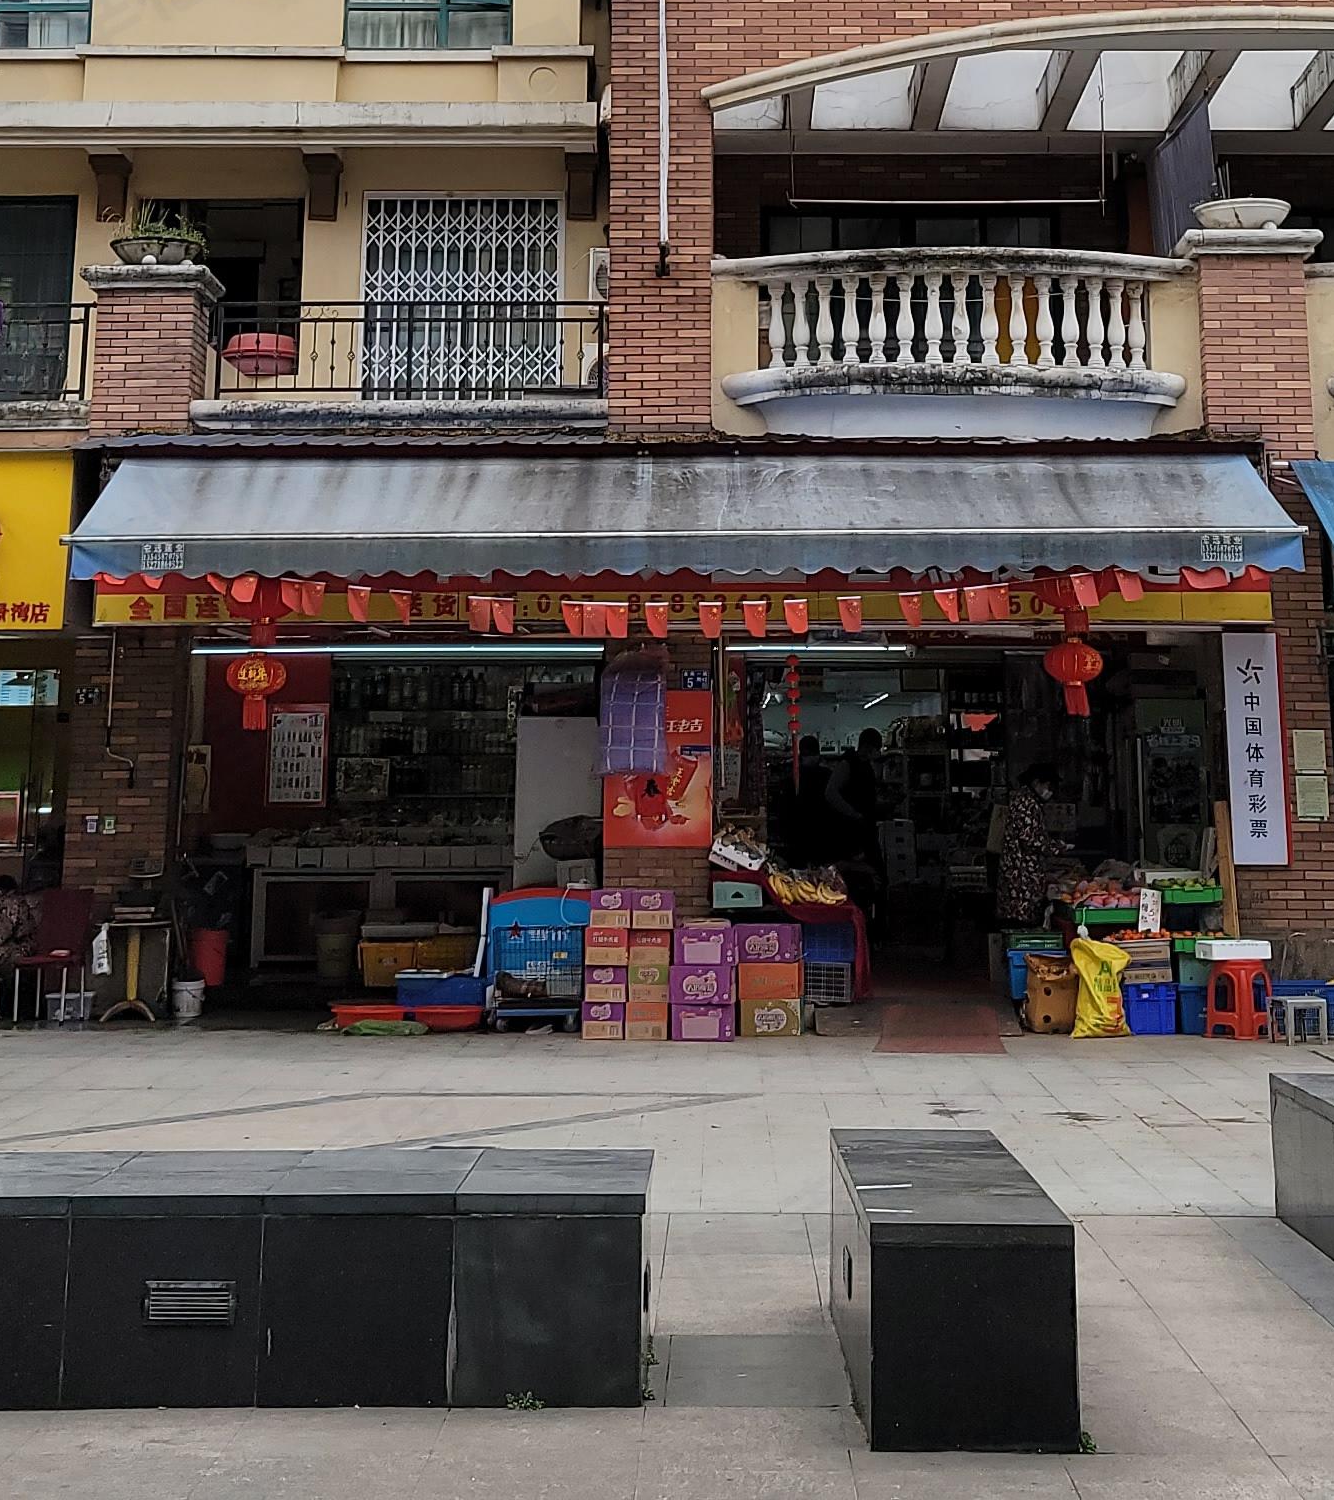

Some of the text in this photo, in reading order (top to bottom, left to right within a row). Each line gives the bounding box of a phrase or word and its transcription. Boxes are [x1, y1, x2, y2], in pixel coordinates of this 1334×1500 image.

[1243, 691, 1269, 839] 中国体育彩票
